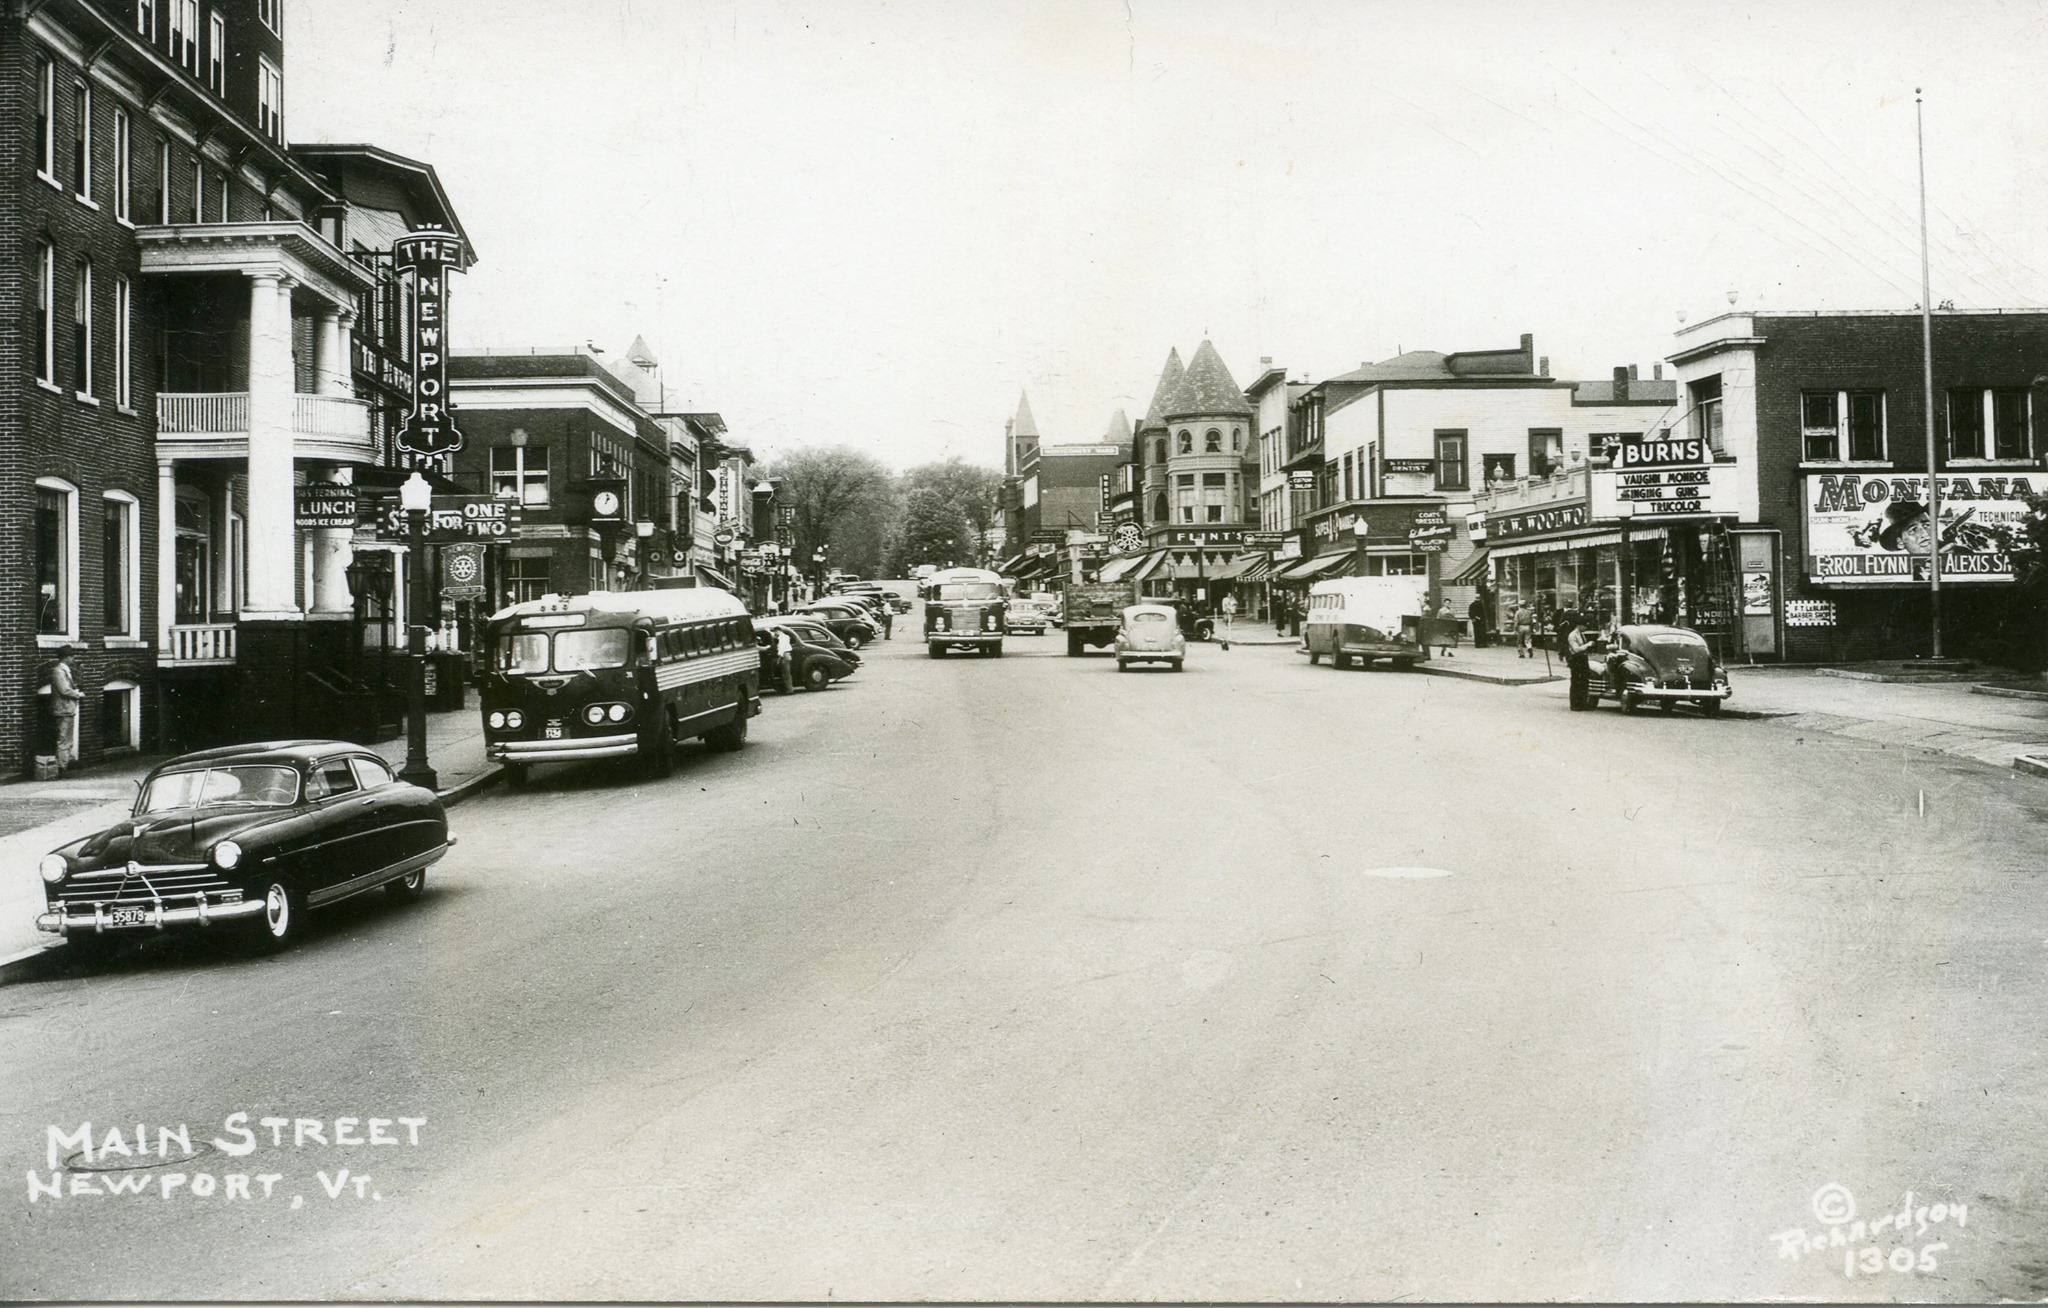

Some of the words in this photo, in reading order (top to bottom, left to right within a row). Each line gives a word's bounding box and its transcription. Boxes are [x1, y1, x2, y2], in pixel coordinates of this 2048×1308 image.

[401, 240, 457, 264] THE
[420, 277, 440, 447] NEWPORT
[1626, 441, 1700, 463] BURNS
[1623, 474, 1661, 485] VAUGHN
[1667, 471, 1709, 483] MONROE
[315, 489, 355, 497] TERMINAL
[1624, 488, 1662, 499] SINGING
[1676, 487, 1699, 497] GUNS
[1814, 475, 2038, 513] MONTANA
[300, 501, 355, 515] LUNCH
[464, 504, 506, 518] ONE
[1650, 501, 1701, 512] TRUCOLOR
[432, 510, 463, 530] FOR
[1979, 511, 2023, 522] TECHNICO
[465, 522, 506, 535] TWO
[1177, 532, 1242, 541] FLINT'S
[1816, 555, 1862, 575] ERROL
[1865, 555, 1908, 574] FLYNN
[1945, 553, 1990, 572] ALEXIS
